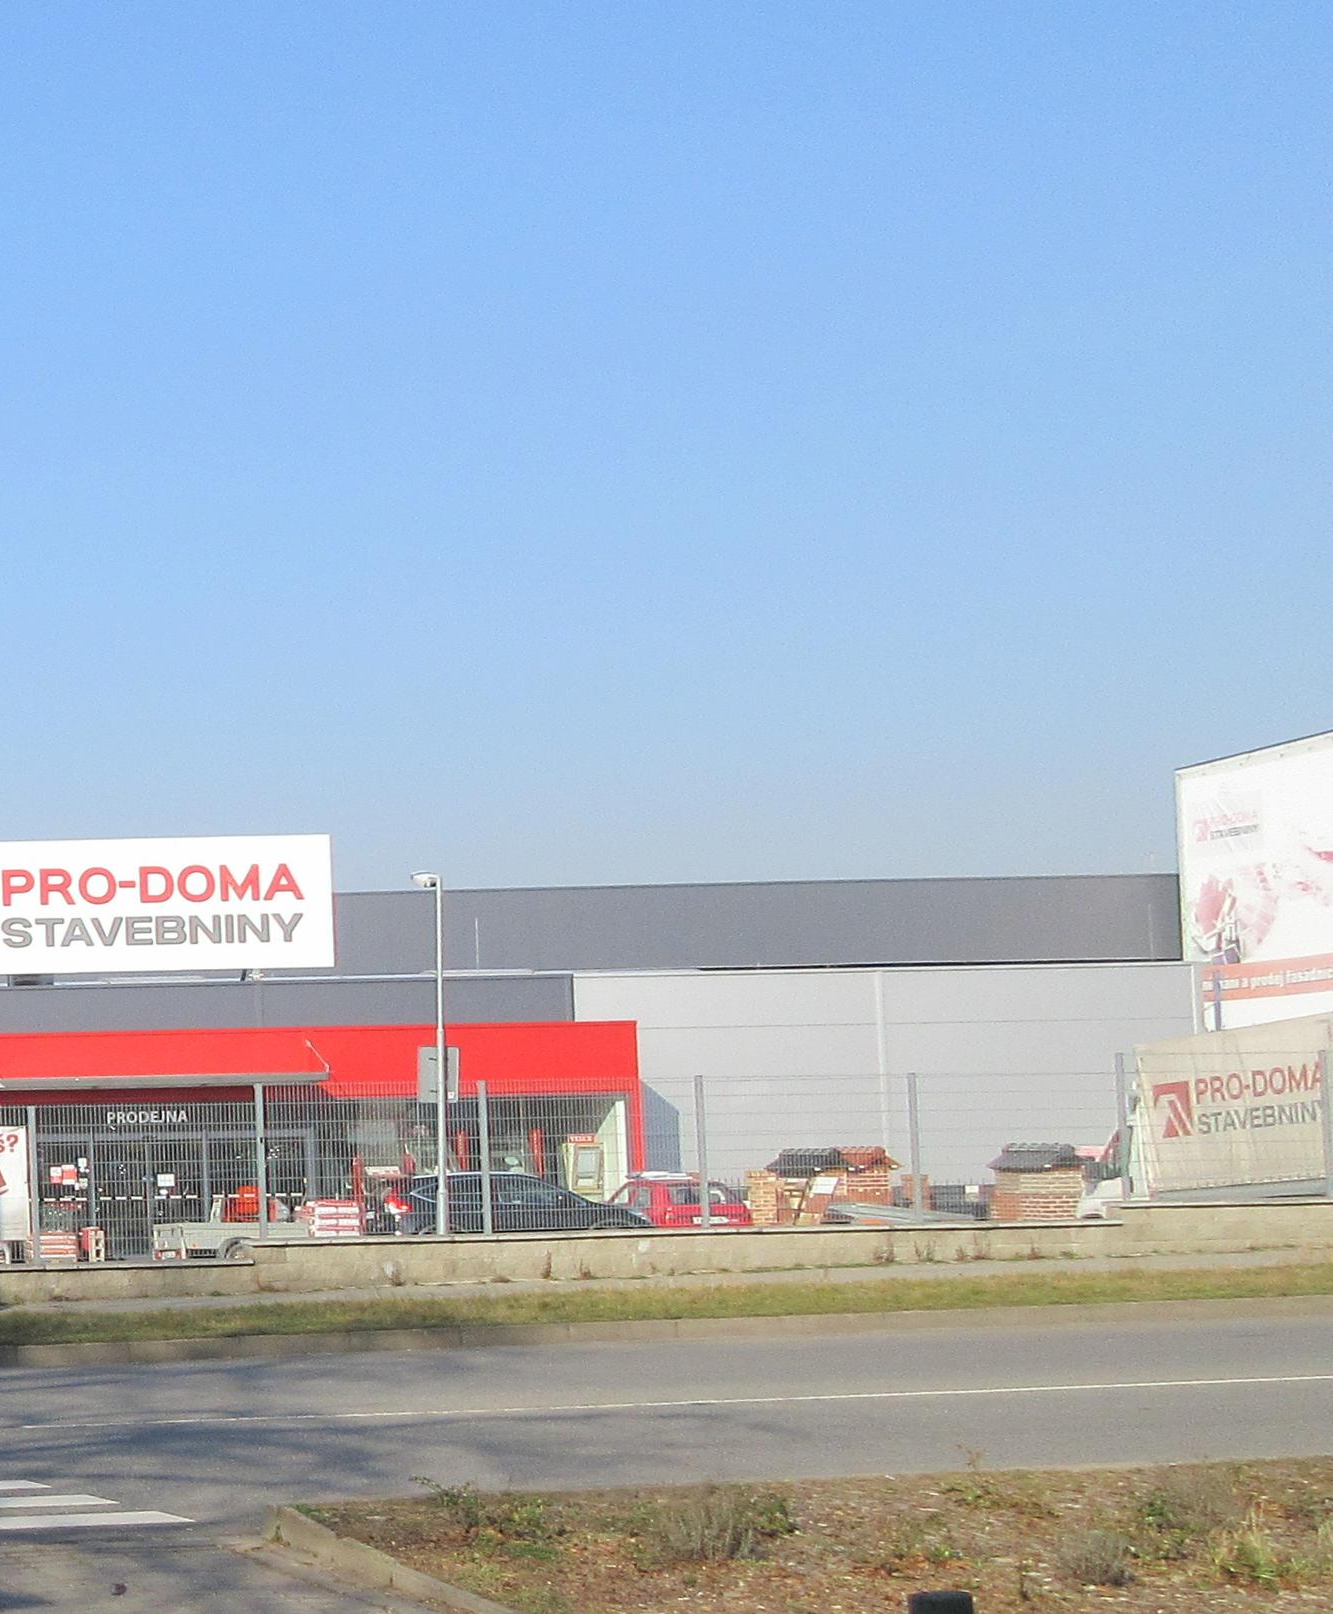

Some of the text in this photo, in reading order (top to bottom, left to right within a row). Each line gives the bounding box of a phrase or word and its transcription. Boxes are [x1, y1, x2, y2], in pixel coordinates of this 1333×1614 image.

[1, 863, 305, 907] PRO-DOMA
[1, 913, 303, 948] STAVEBNINY
[1250, 971, 1284, 990] prodej
[106, 1110, 188, 1124] PRODEJNA
